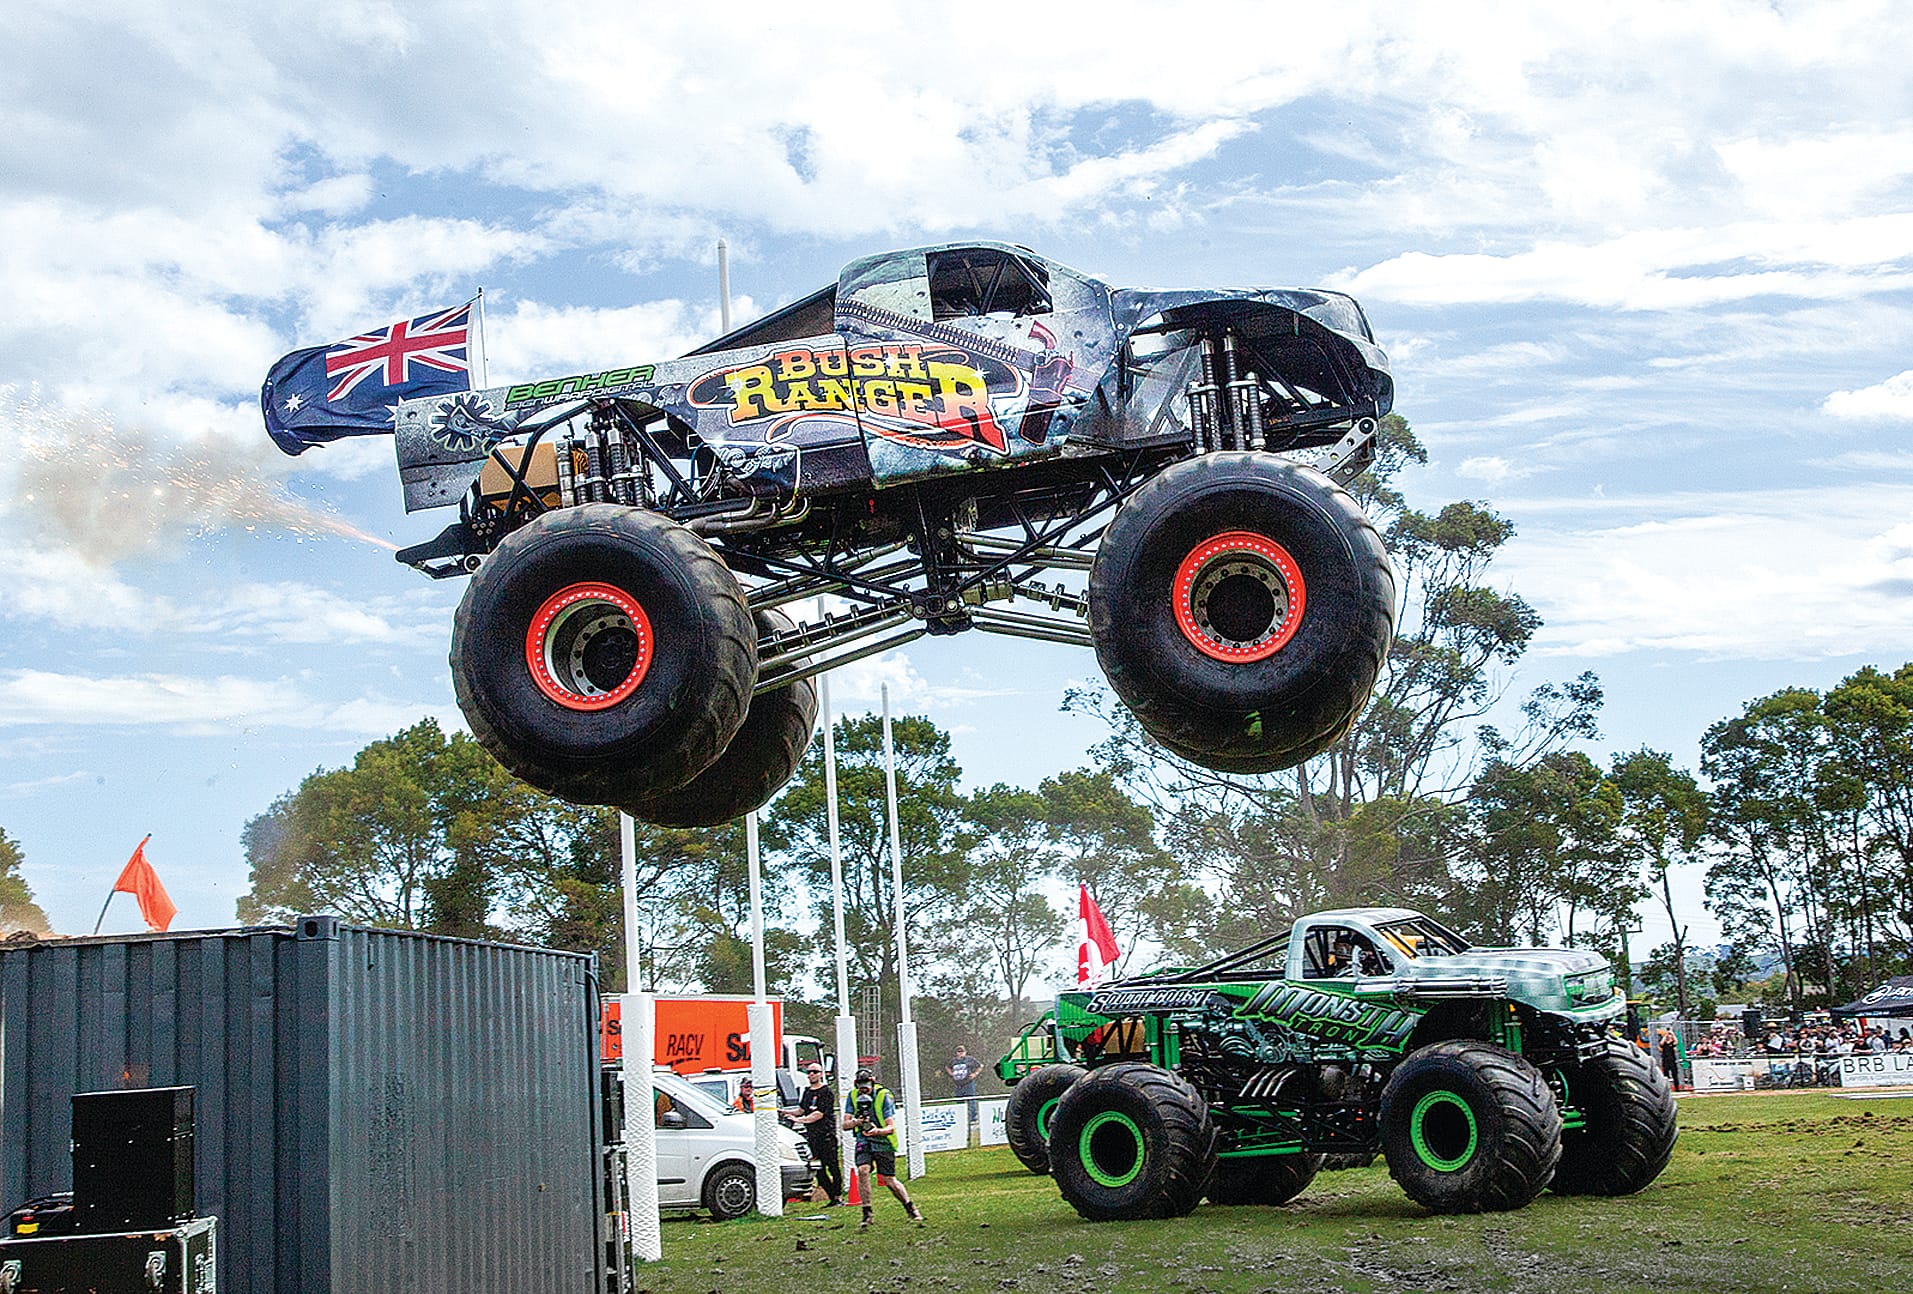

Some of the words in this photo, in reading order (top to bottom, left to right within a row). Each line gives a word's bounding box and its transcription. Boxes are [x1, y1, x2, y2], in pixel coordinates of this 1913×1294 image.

[773, 344, 924, 382] BUSH
[505, 364, 656, 403] BENHER
[723, 360, 1006, 452] RANGER
[1086, 990, 1156, 1014] SOUTH
[1154, 988, 1218, 1010] COAST
[1293, 1016, 1359, 1043] TRON
[665, 1033, 704, 1057] RACV
[1842, 1056, 1886, 1074] BRB
